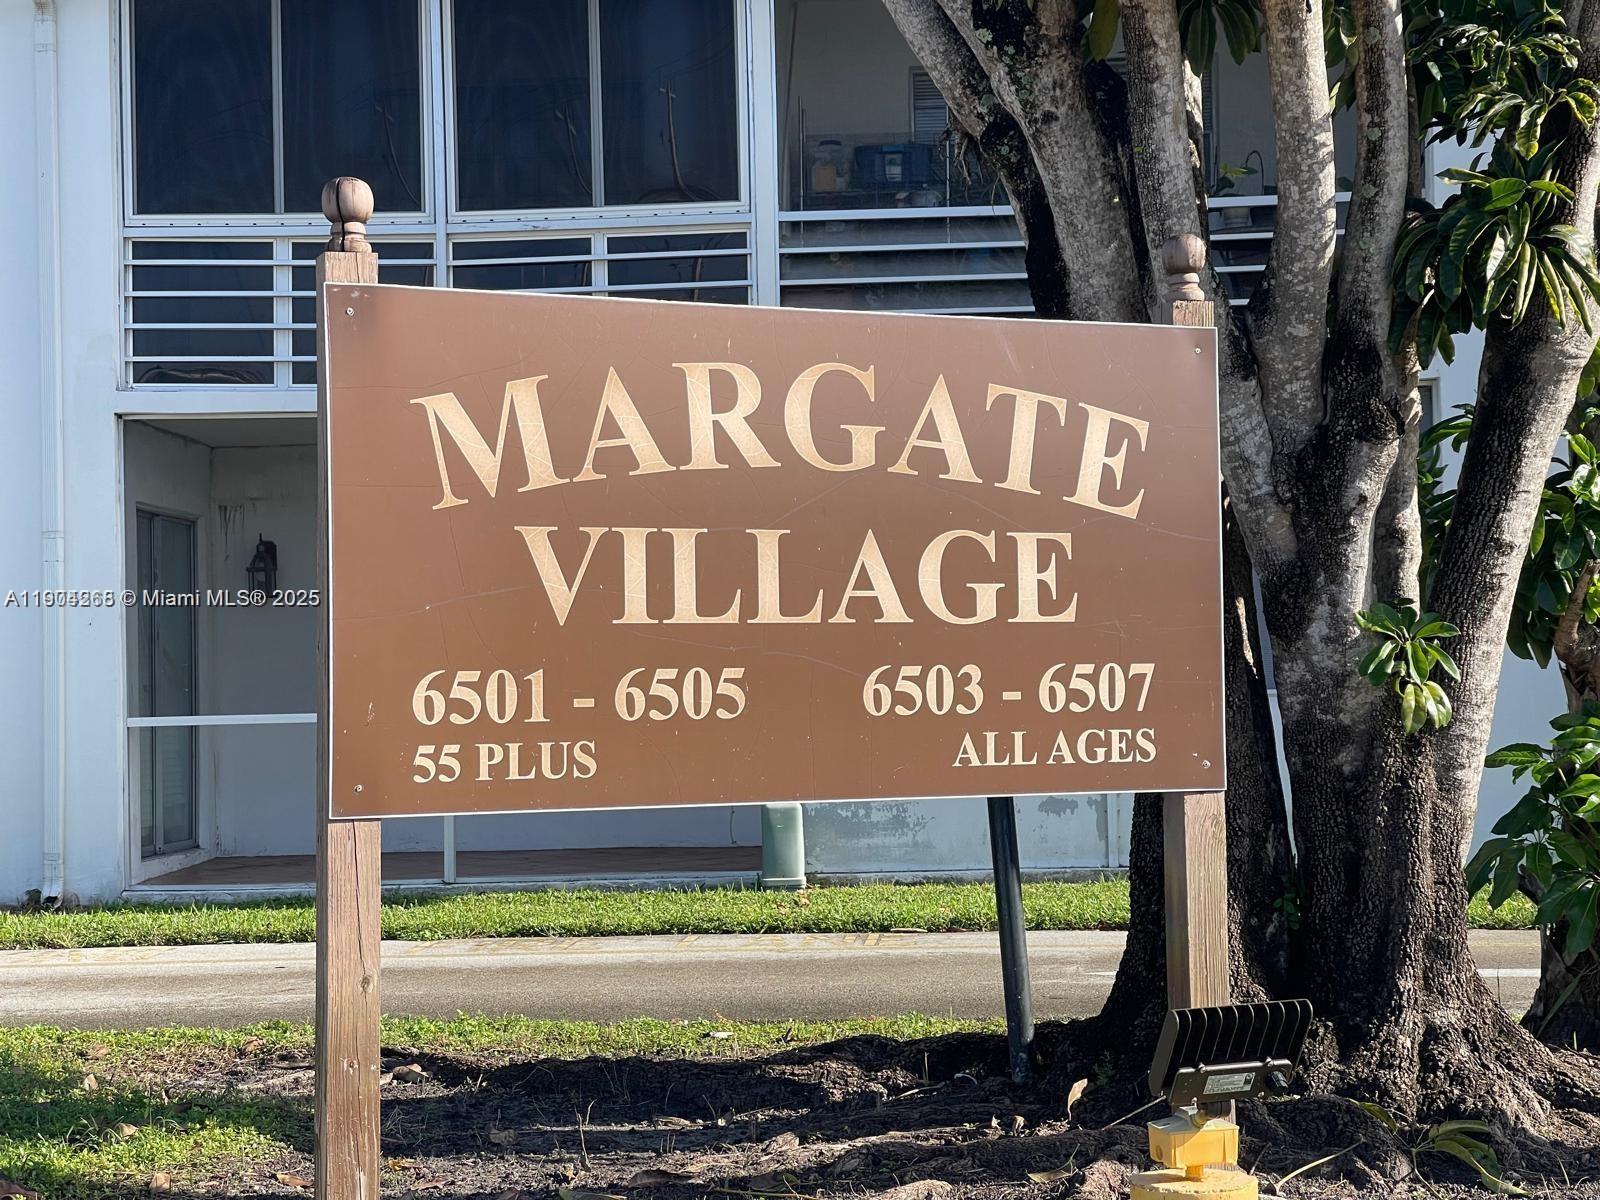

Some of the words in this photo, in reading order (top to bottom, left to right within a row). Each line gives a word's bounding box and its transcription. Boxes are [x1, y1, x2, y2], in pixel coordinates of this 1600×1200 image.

[410, 362, 1150, 520] MARGATE
[514, 526, 1078, 626] VILLAGE
[412, 668, 549, 725] 6501
[573, 697, 595, 708] -
[615, 667, 746, 721] 6505
[863, 664, 984, 716] 6503
[1002, 691, 1022, 701] -
[1039, 663, 1155, 713] 6507
[413, 744, 461, 783] 55
[475, 740, 598, 781] PLUS
[952, 730, 1037, 767] ALL
[1046, 728, 1157, 765] AGES
